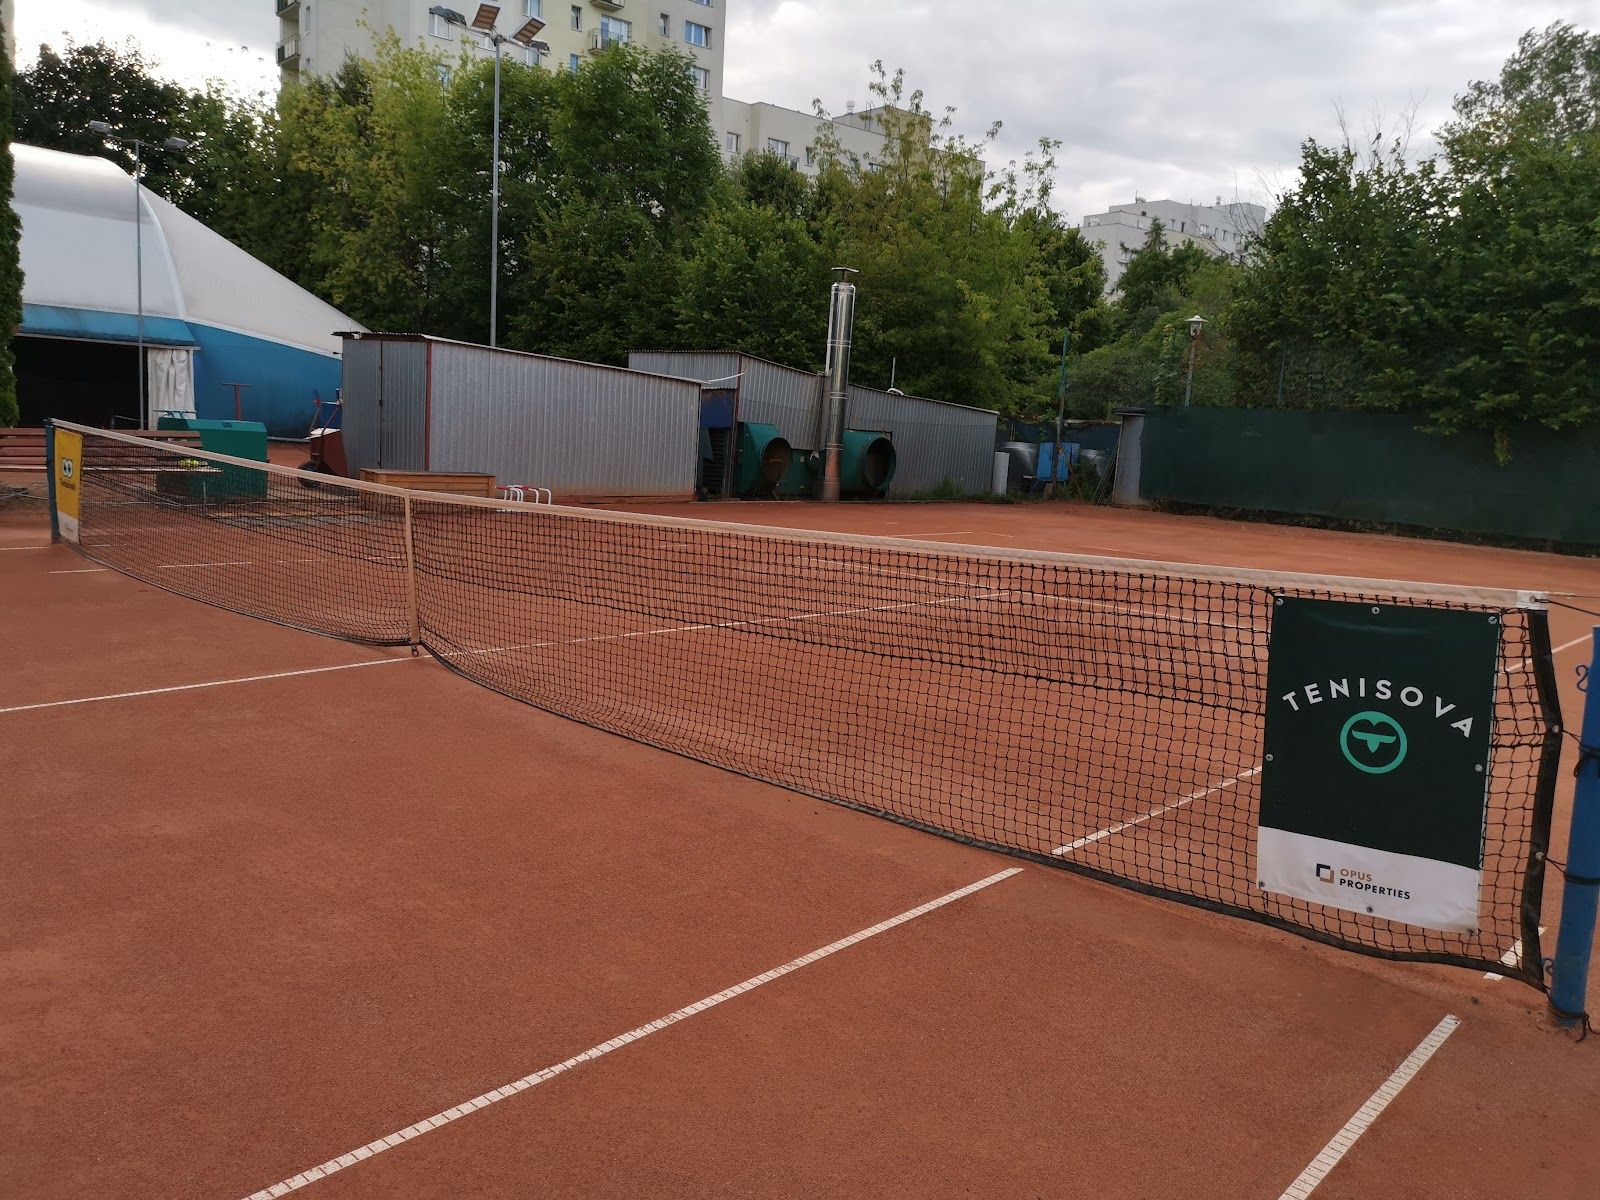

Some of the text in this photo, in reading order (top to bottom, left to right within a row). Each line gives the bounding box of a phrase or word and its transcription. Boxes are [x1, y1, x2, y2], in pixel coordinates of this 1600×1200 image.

[1282, 678, 1473, 738] TENISOVA
[1340, 868, 1373, 882] OPUS
[1340, 878, 1411, 900] PROPERTIES
